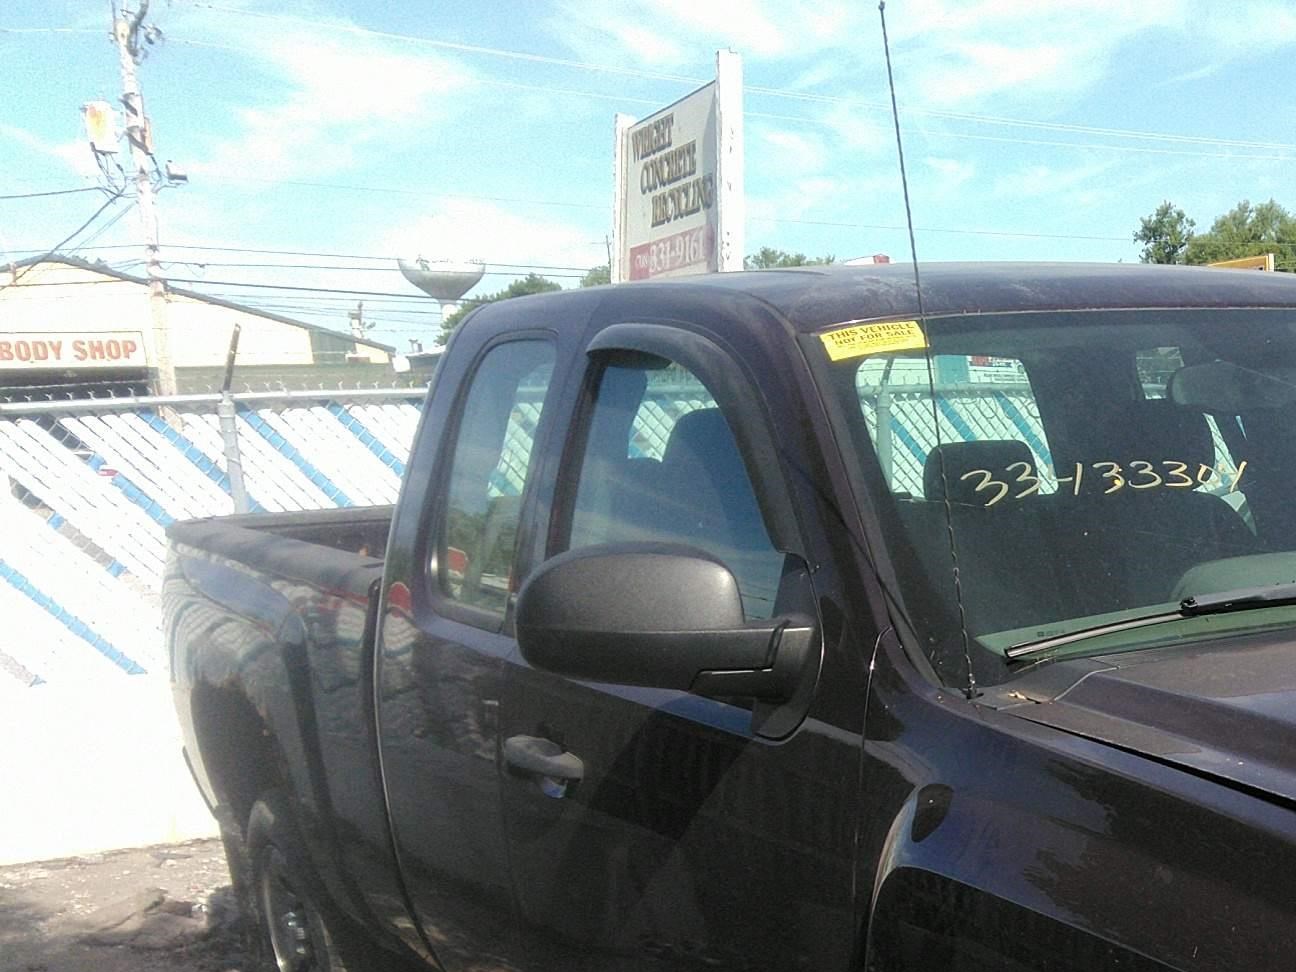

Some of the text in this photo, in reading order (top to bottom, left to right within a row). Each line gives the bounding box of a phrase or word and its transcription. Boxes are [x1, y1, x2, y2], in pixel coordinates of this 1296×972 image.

[641, 138, 697, 194] CONCRETE
[651, 172, 714, 227] RECYCLING
[829, 322, 915, 341] THIS VEHICLE
[835, 336, 856, 346] NOT
[860, 332, 882, 341] FOR
[887, 329, 914, 337] SALE
[0, 339, 137, 361] BODY SHOP
